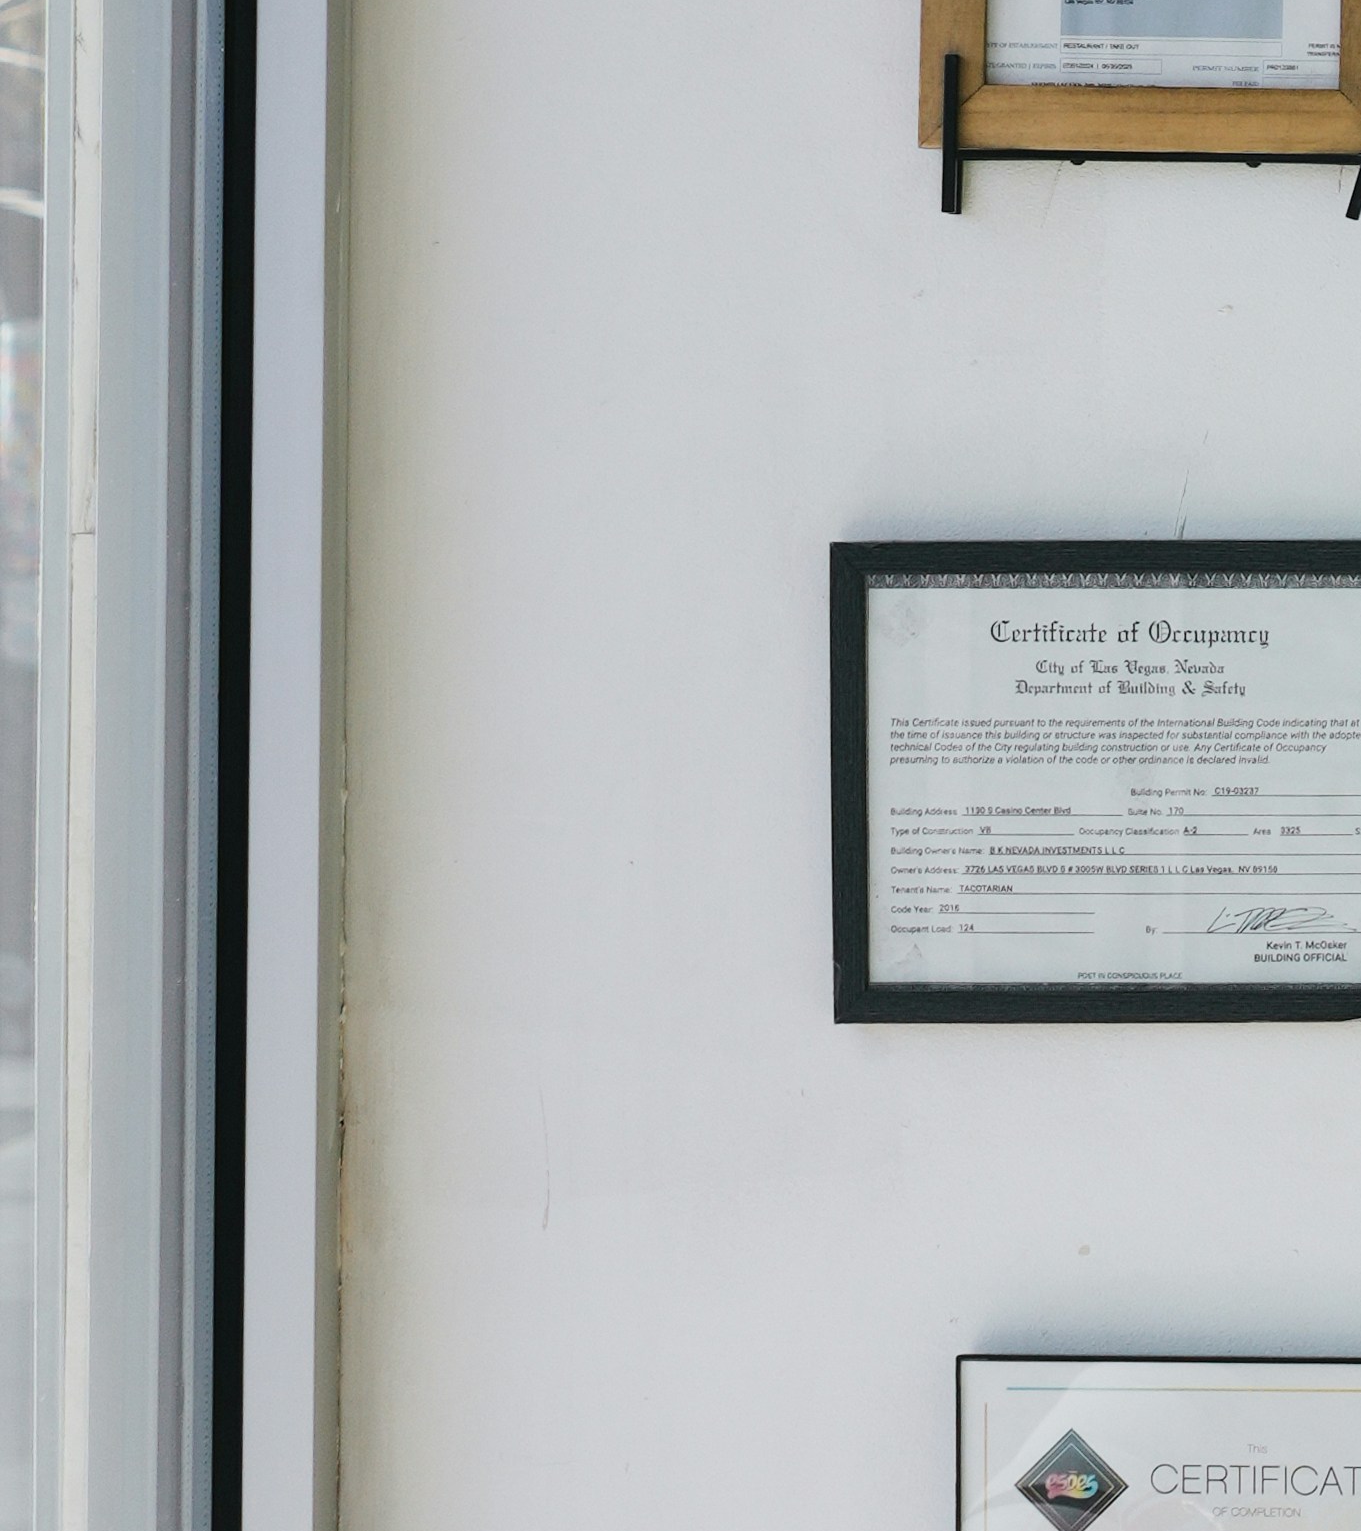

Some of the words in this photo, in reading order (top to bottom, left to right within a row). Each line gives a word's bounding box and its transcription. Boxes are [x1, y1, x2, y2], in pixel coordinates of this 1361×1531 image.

[991, 621, 1106, 642] Certificate
[1118, 621, 1140, 642] of
[1149, 620, 1268, 648] Occupancy
[1036, 660, 1064, 675] City
[1071, 660, 1084, 673] of
[1090, 660, 1118, 673] Las
[1175, 659, 1224, 674] Nevada
[1016, 680, 1092, 696] Department
[1099, 681, 1112, 693] of
[1117, 680, 1175, 696] Building
[1182, 681, 1195, 694] &
[1202, 680, 1245, 697] Safety
[957, 884, 1016, 895] TACOTARIAN
[1266, 941, 1293, 951] Kevin
[1295, 940, 1303, 950] T.
[1253, 952, 1301, 963] BUILDING
[1302, 952, 1348, 963] OFFICIAL
[1212, 1506, 1228, 1517] OF
[1231, 1507, 1301, 1518] COMPLETION
